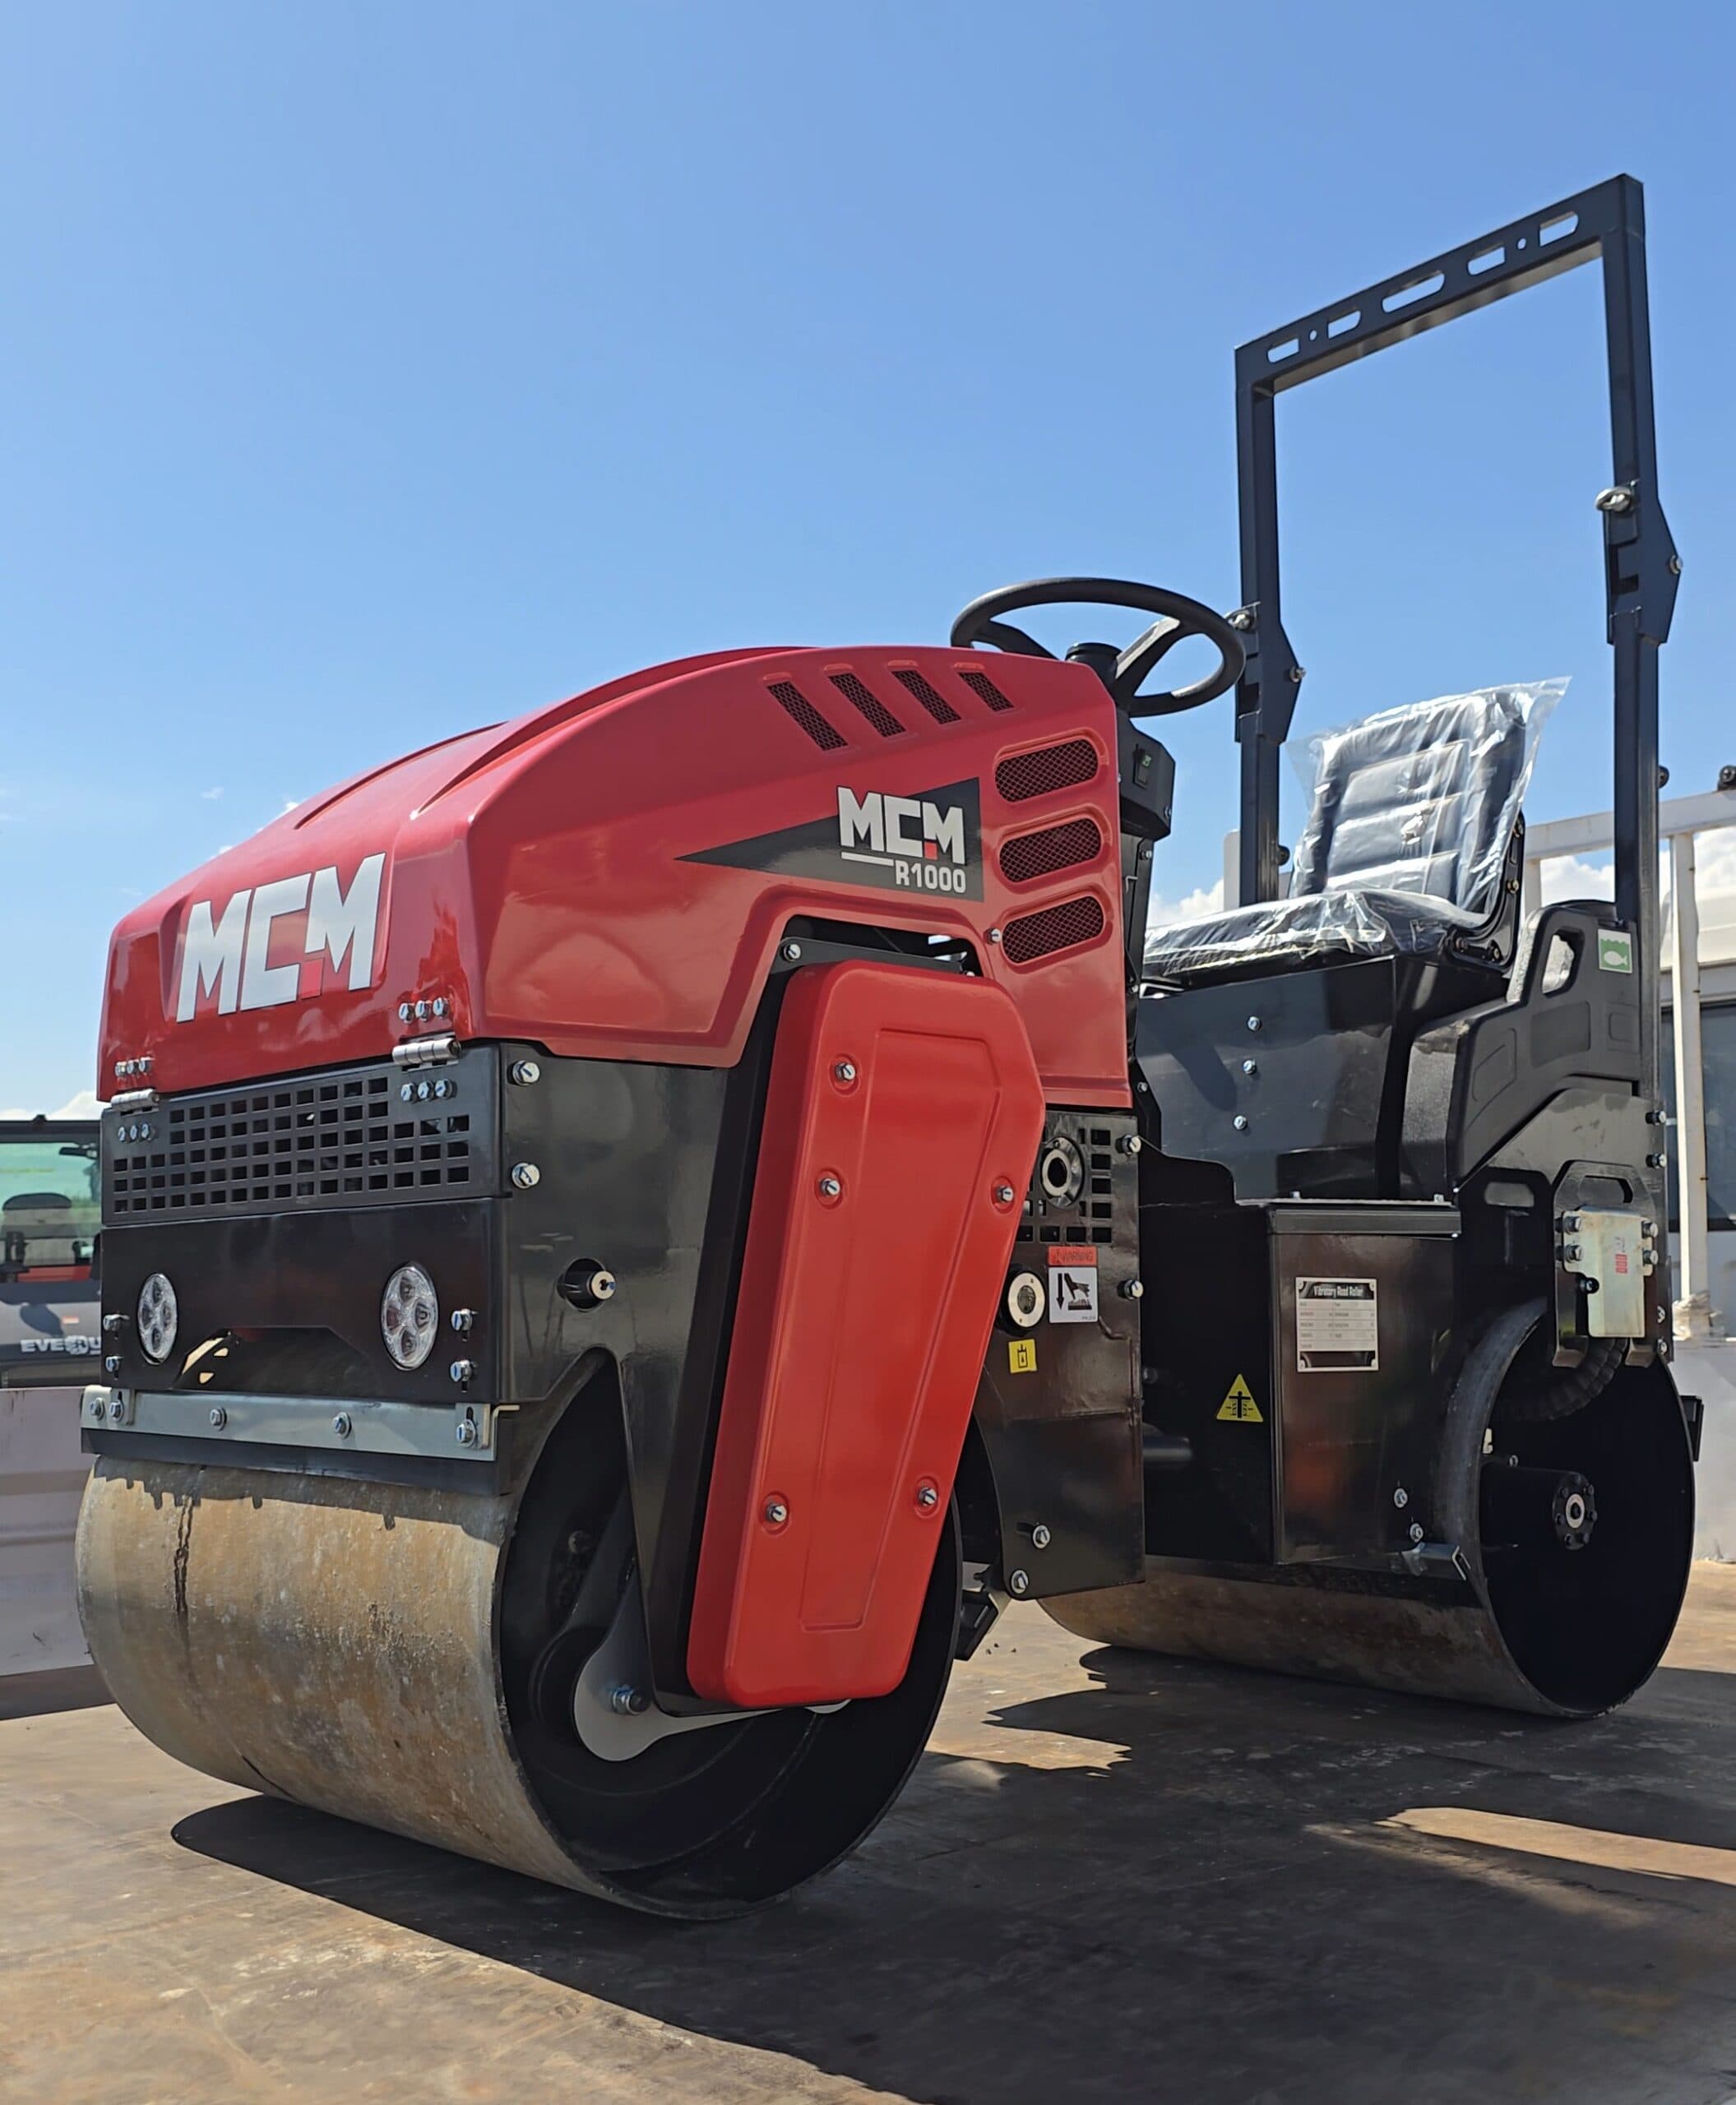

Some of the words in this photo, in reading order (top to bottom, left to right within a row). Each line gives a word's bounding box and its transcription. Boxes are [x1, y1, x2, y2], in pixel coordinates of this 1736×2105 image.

[837, 785, 966, 865] MCM
[894, 859, 966, 894] R1000
[175, 852, 387, 1023] MCM
